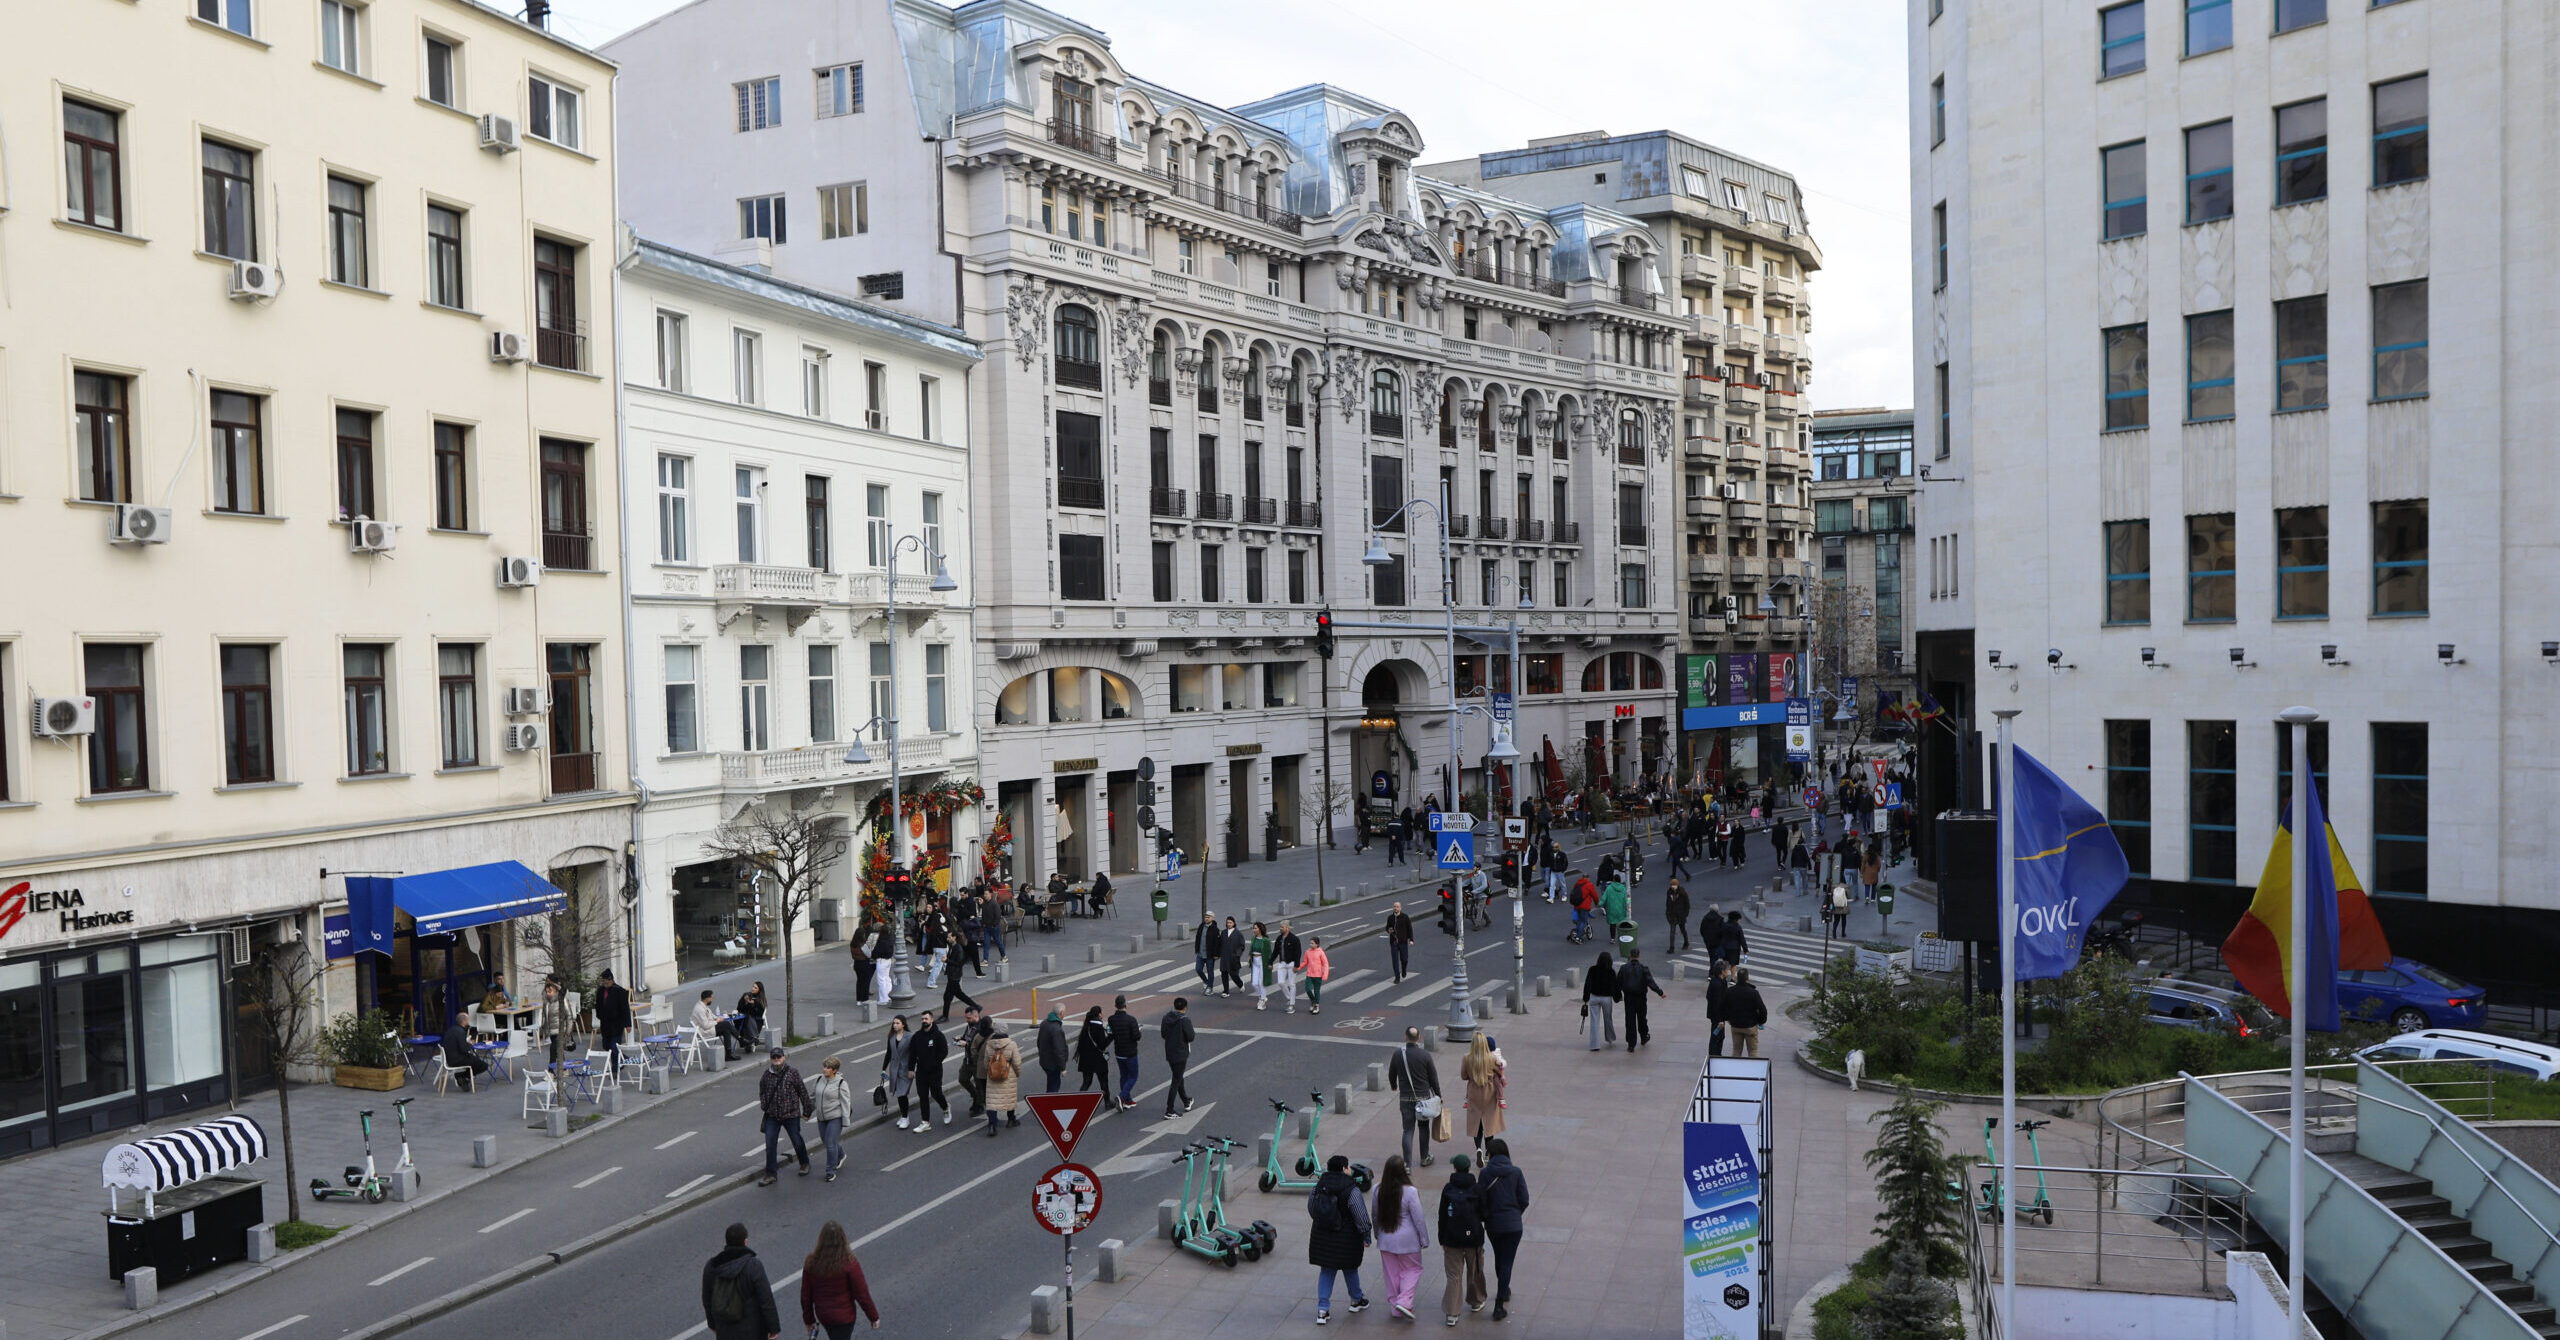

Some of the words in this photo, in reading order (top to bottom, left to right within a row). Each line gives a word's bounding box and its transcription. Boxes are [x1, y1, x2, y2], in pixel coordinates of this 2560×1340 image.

[1443, 821, 1469, 830] NOVOTEL
[1697, 1171, 1748, 1192] deschise
[1692, 1215, 1728, 1231] Calea
[1695, 1217, 1752, 1242] Victoriei
[1724, 1265, 1750, 1278] 2025
